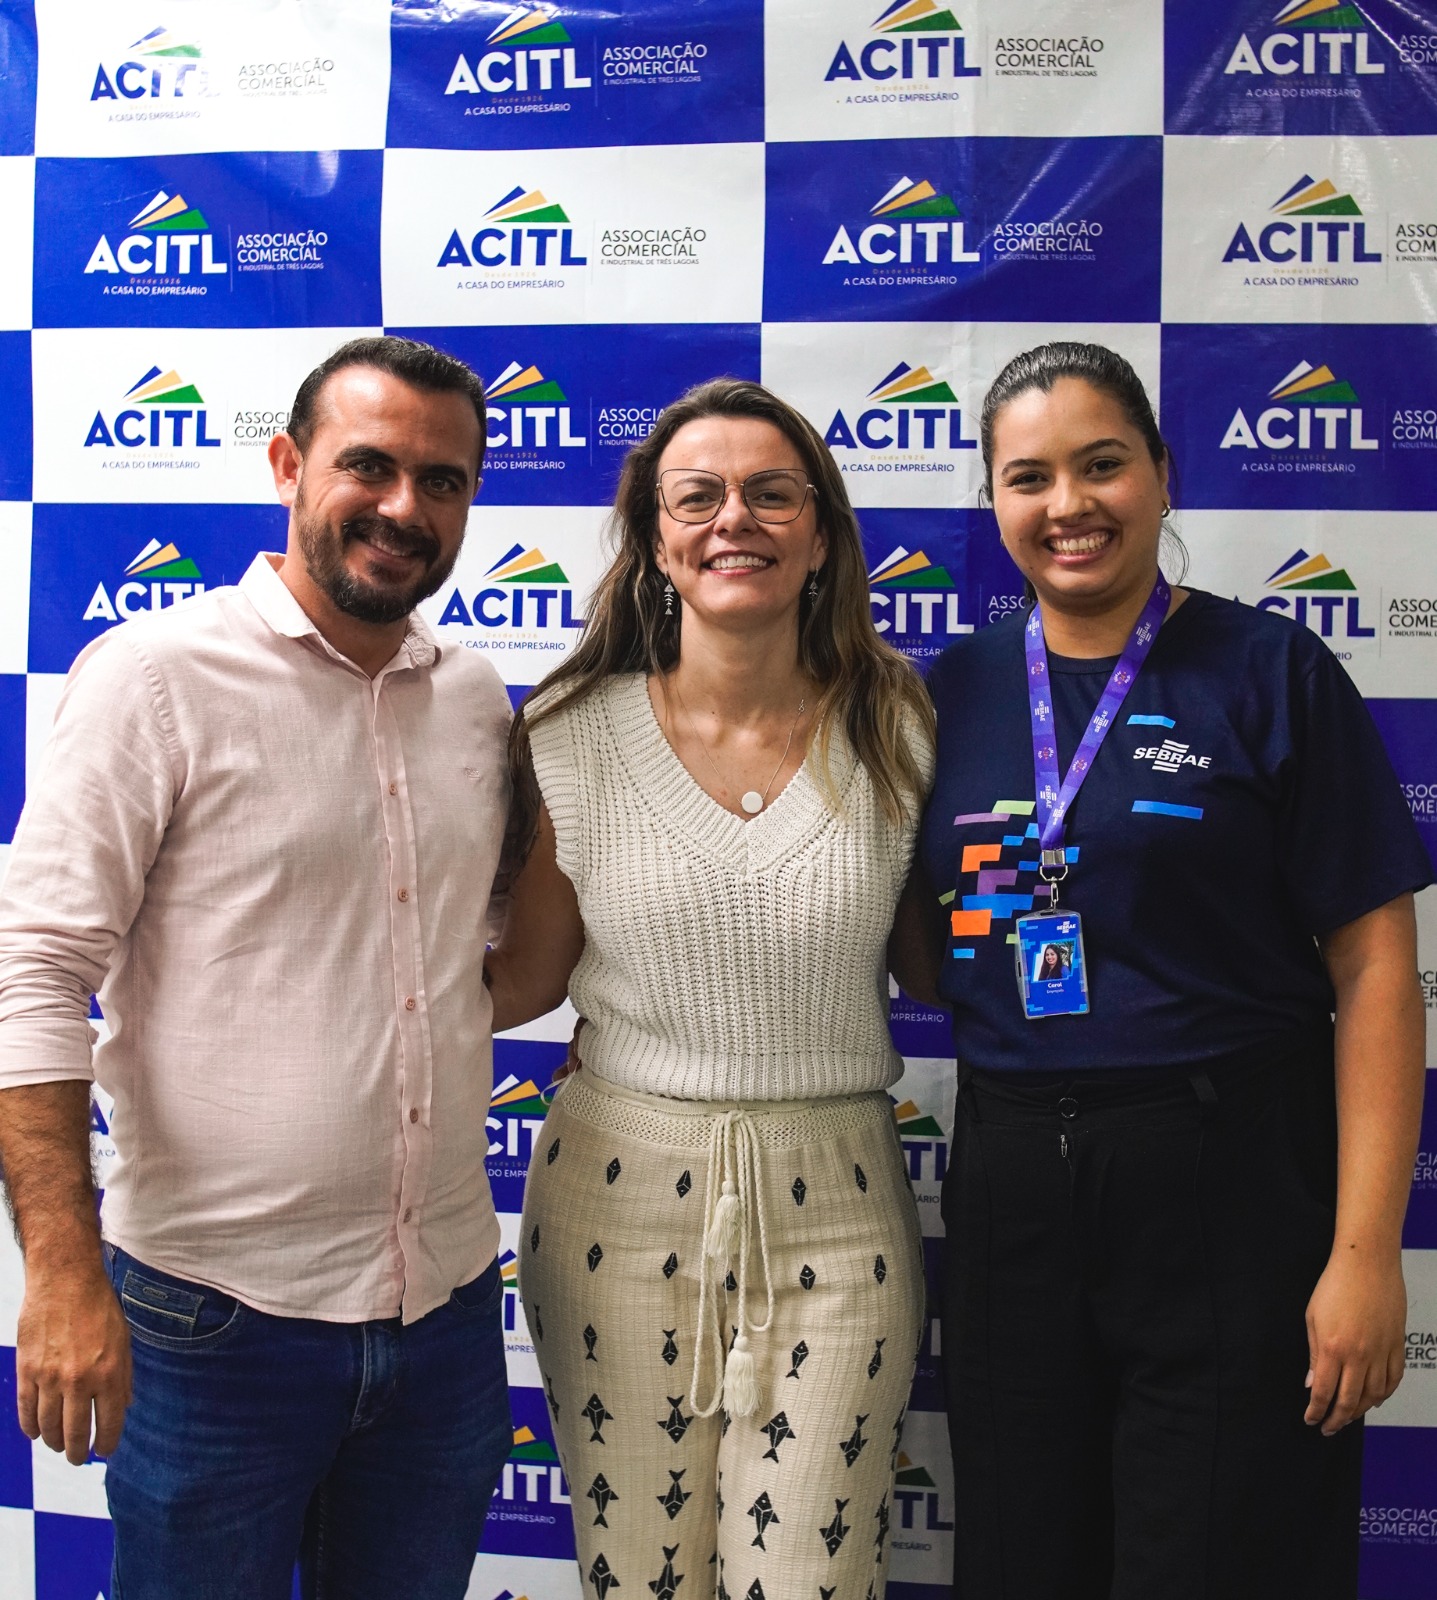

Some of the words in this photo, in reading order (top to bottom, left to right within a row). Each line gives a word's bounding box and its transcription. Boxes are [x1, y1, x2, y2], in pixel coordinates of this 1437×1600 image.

[603, 42, 707, 62] ASSOCIAÇÃO
[996, 37, 1103, 55] ASSOCIAÇÃO
[1224, 33, 1385, 75] ACITL
[238, 57, 334, 76] ASSOCIAÇÃO
[824, 37, 981, 81] ACITL
[996, 54, 1094, 68] COMERCIAL
[444, 48, 591, 95] ACITL
[603, 61, 698, 76] COMERCIAL
[238, 74, 325, 90] COMERCIAL
[855, 95, 879, 103] CASA
[882, 94, 896, 102] DO
[899, 91, 959, 102] EMPRESÁRIO
[473, 106, 496, 115] CASA
[498, 105, 513, 114] DO
[514, 102, 571, 114] EMPRESÁRIO
[602, 228, 706, 244] ASSOCIAÇÃO
[994, 220, 1103, 238] ASSOCIAÇÃO
[237, 230, 328, 249] ASSOCIAÇÃO
[437, 228, 587, 267] ACITL
[822, 222, 980, 264] ACITL
[994, 238, 1093, 252] COMERCIAL
[1222, 222, 1382, 263] ACITL
[84, 234, 227, 274] ACITL
[238, 247, 321, 262] COMERCIAL
[602, 244, 696, 257] COMERCIAL
[1051, 253, 1068, 261] TRÊS
[507, 279, 565, 289] EMPRESÁRIO
[852, 277, 876, 285] CASA
[897, 274, 957, 285] EMPRESÁRIO
[1299, 276, 1359, 286] EMPRESÁRIO
[111, 287, 134, 295] CASA
[152, 285, 207, 295] EMPRESÁRIO
[234, 412, 289, 424] ASSOCI
[598, 408, 664, 422] ASSOCIA
[84, 410, 221, 447] ACITL
[487, 407, 586, 447] CITL
[598, 424, 656, 437] COMER
[824, 408, 977, 449] ACITL
[1219, 407, 1378, 450] ACITL
[148, 460, 200, 469] EMPRESÁRIO
[482, 461, 492, 469] SA
[510, 460, 565, 470] EMPRESÁRIO
[895, 462, 954, 472] EMPRESÁRIO
[1242, 464, 1248, 472] A
[1250, 464, 1275, 472] CASA
[1278, 464, 1293, 472] DO
[1296, 462, 1356, 472] EMPRESÁRIO
[438, 587, 585, 628] ACITL
[870, 593, 974, 633] CITL
[1233, 596, 1375, 637] ITL
[509, 640, 566, 650] EMPRESÁRIO
[894, 646, 944, 656] MPRESÁR
[1094, 710, 1108, 733] SEBRAE
[1133, 747, 1212, 769] SEBRAE
[891, 1012, 944, 1023] MPRESÁRIO
[485, 1116, 546, 1156] CIT
[492, 1462, 572, 1504] ITL
[1360, 1507, 1437, 1524] ASSOCIAÇ
[1359, 1522, 1437, 1536] COMERCI
